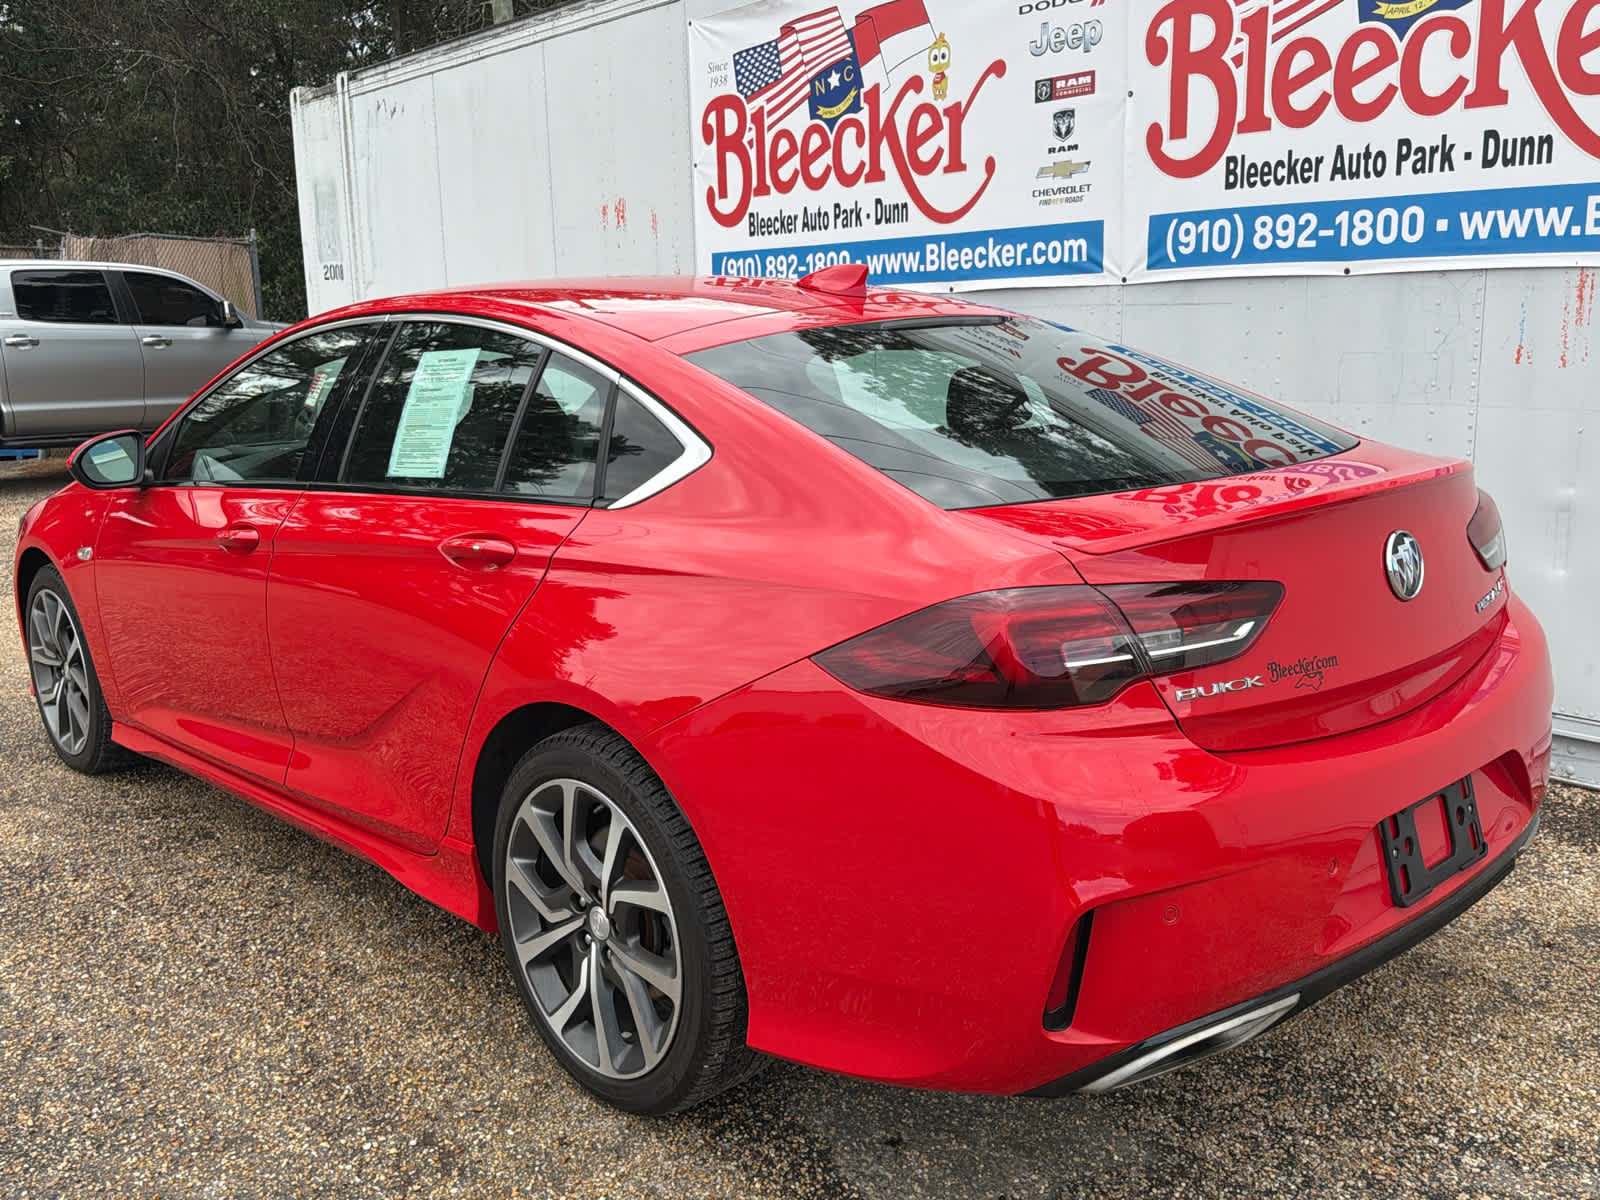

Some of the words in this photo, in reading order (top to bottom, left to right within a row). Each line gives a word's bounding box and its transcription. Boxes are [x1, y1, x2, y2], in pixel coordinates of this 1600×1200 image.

[1029, 18, 1103, 57] Jeep
[707, 62, 728, 74] Since
[709, 74, 728, 88] 1938
[815, 78, 825, 96] N
[843, 65, 854, 82] C
[1055, 75, 1092, 89] RAM
[702, 58, 1007, 228] Bleecker
[1048, 144, 1079, 154] RAM
[1225, 149, 1325, 190] Bleecker
[1330, 143, 1387, 181] Auto
[1395, 134, 1456, 176] Park
[1481, 129, 1554, 169] Dunn
[1032, 183, 1093, 198] CHEVROLET
[749, 209, 798, 237] Bleecker
[801, 206, 829, 232] Auto
[833, 200, 863, 229] Park
[874, 198, 909, 225] Dunn
[1166, 214, 1243, 262] (910)
[1253, 205, 1425, 250] 892-1800
[721, 254, 762, 277] (910)
[866, 234, 1088, 275] www.Bleecker.com
[1266, 655, 1338, 683] Bleecker.com
[1175, 675, 1264, 701] BUICK
